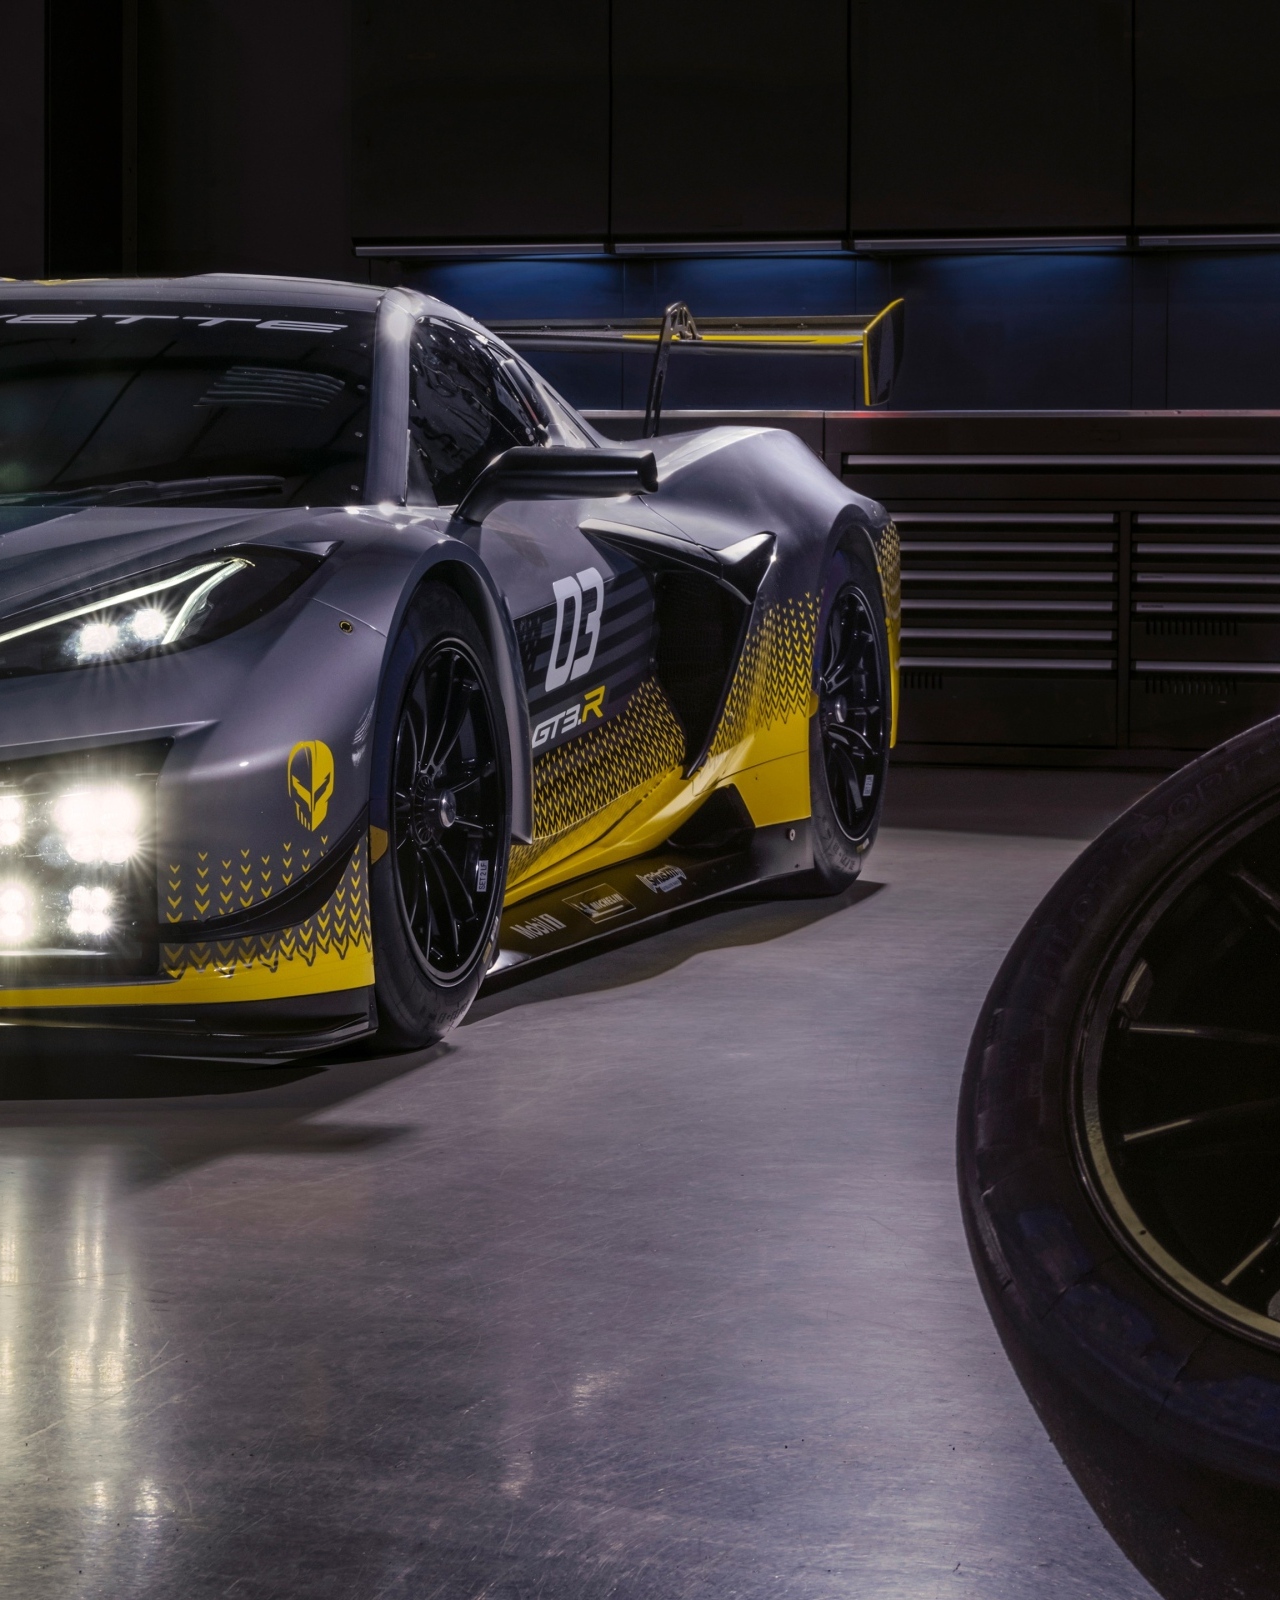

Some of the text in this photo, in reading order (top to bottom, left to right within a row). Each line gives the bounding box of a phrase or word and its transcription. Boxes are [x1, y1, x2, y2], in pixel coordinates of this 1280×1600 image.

[545, 567, 604, 692] 03
[532, 685, 605, 748] GT3.R
[478, 878, 486, 890] SET
[589, 893, 623, 910] MICHELIN
